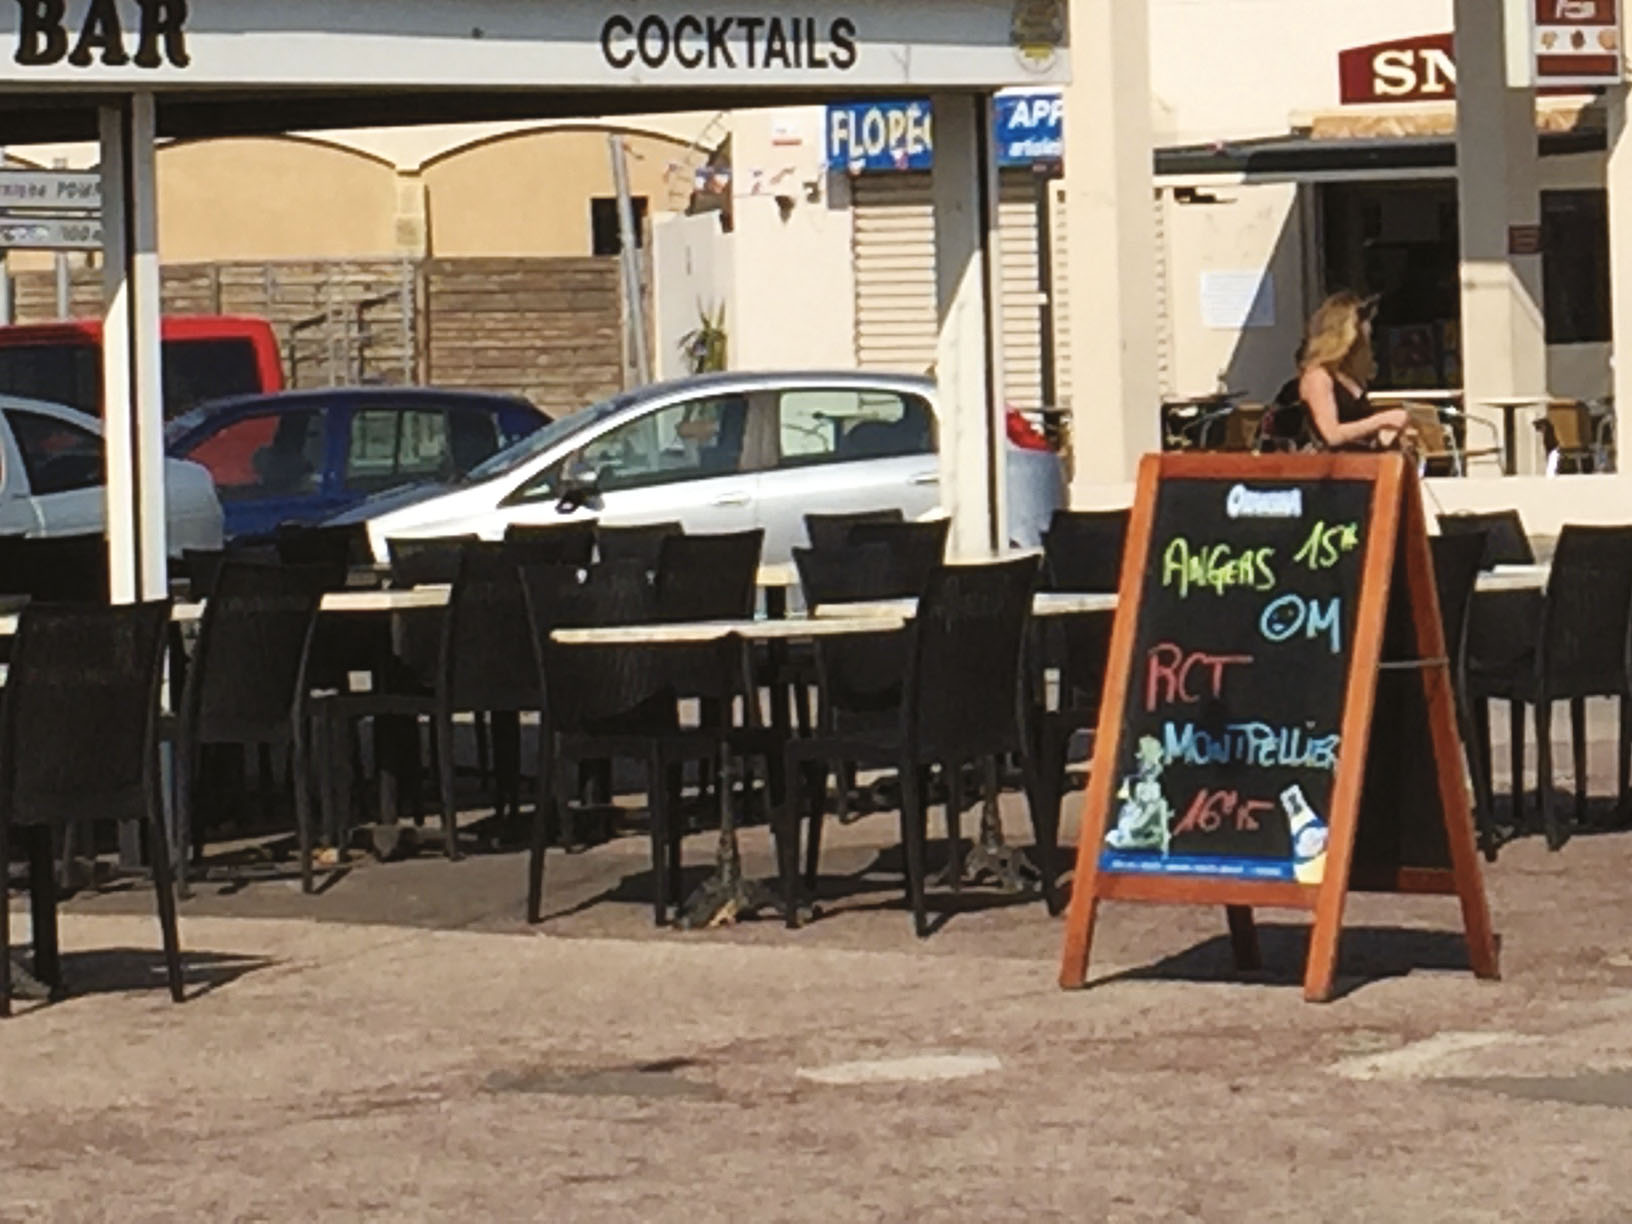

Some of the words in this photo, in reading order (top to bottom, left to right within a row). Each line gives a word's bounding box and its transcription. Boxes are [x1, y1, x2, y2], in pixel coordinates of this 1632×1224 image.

[601, 13, 858, 70] COCKTAILS
[1008, 98, 1063, 129] APP
[1162, 537, 1277, 598] ANGERS
[1260, 594, 1341, 653] OM
[1145, 642, 1254, 713] RCT
